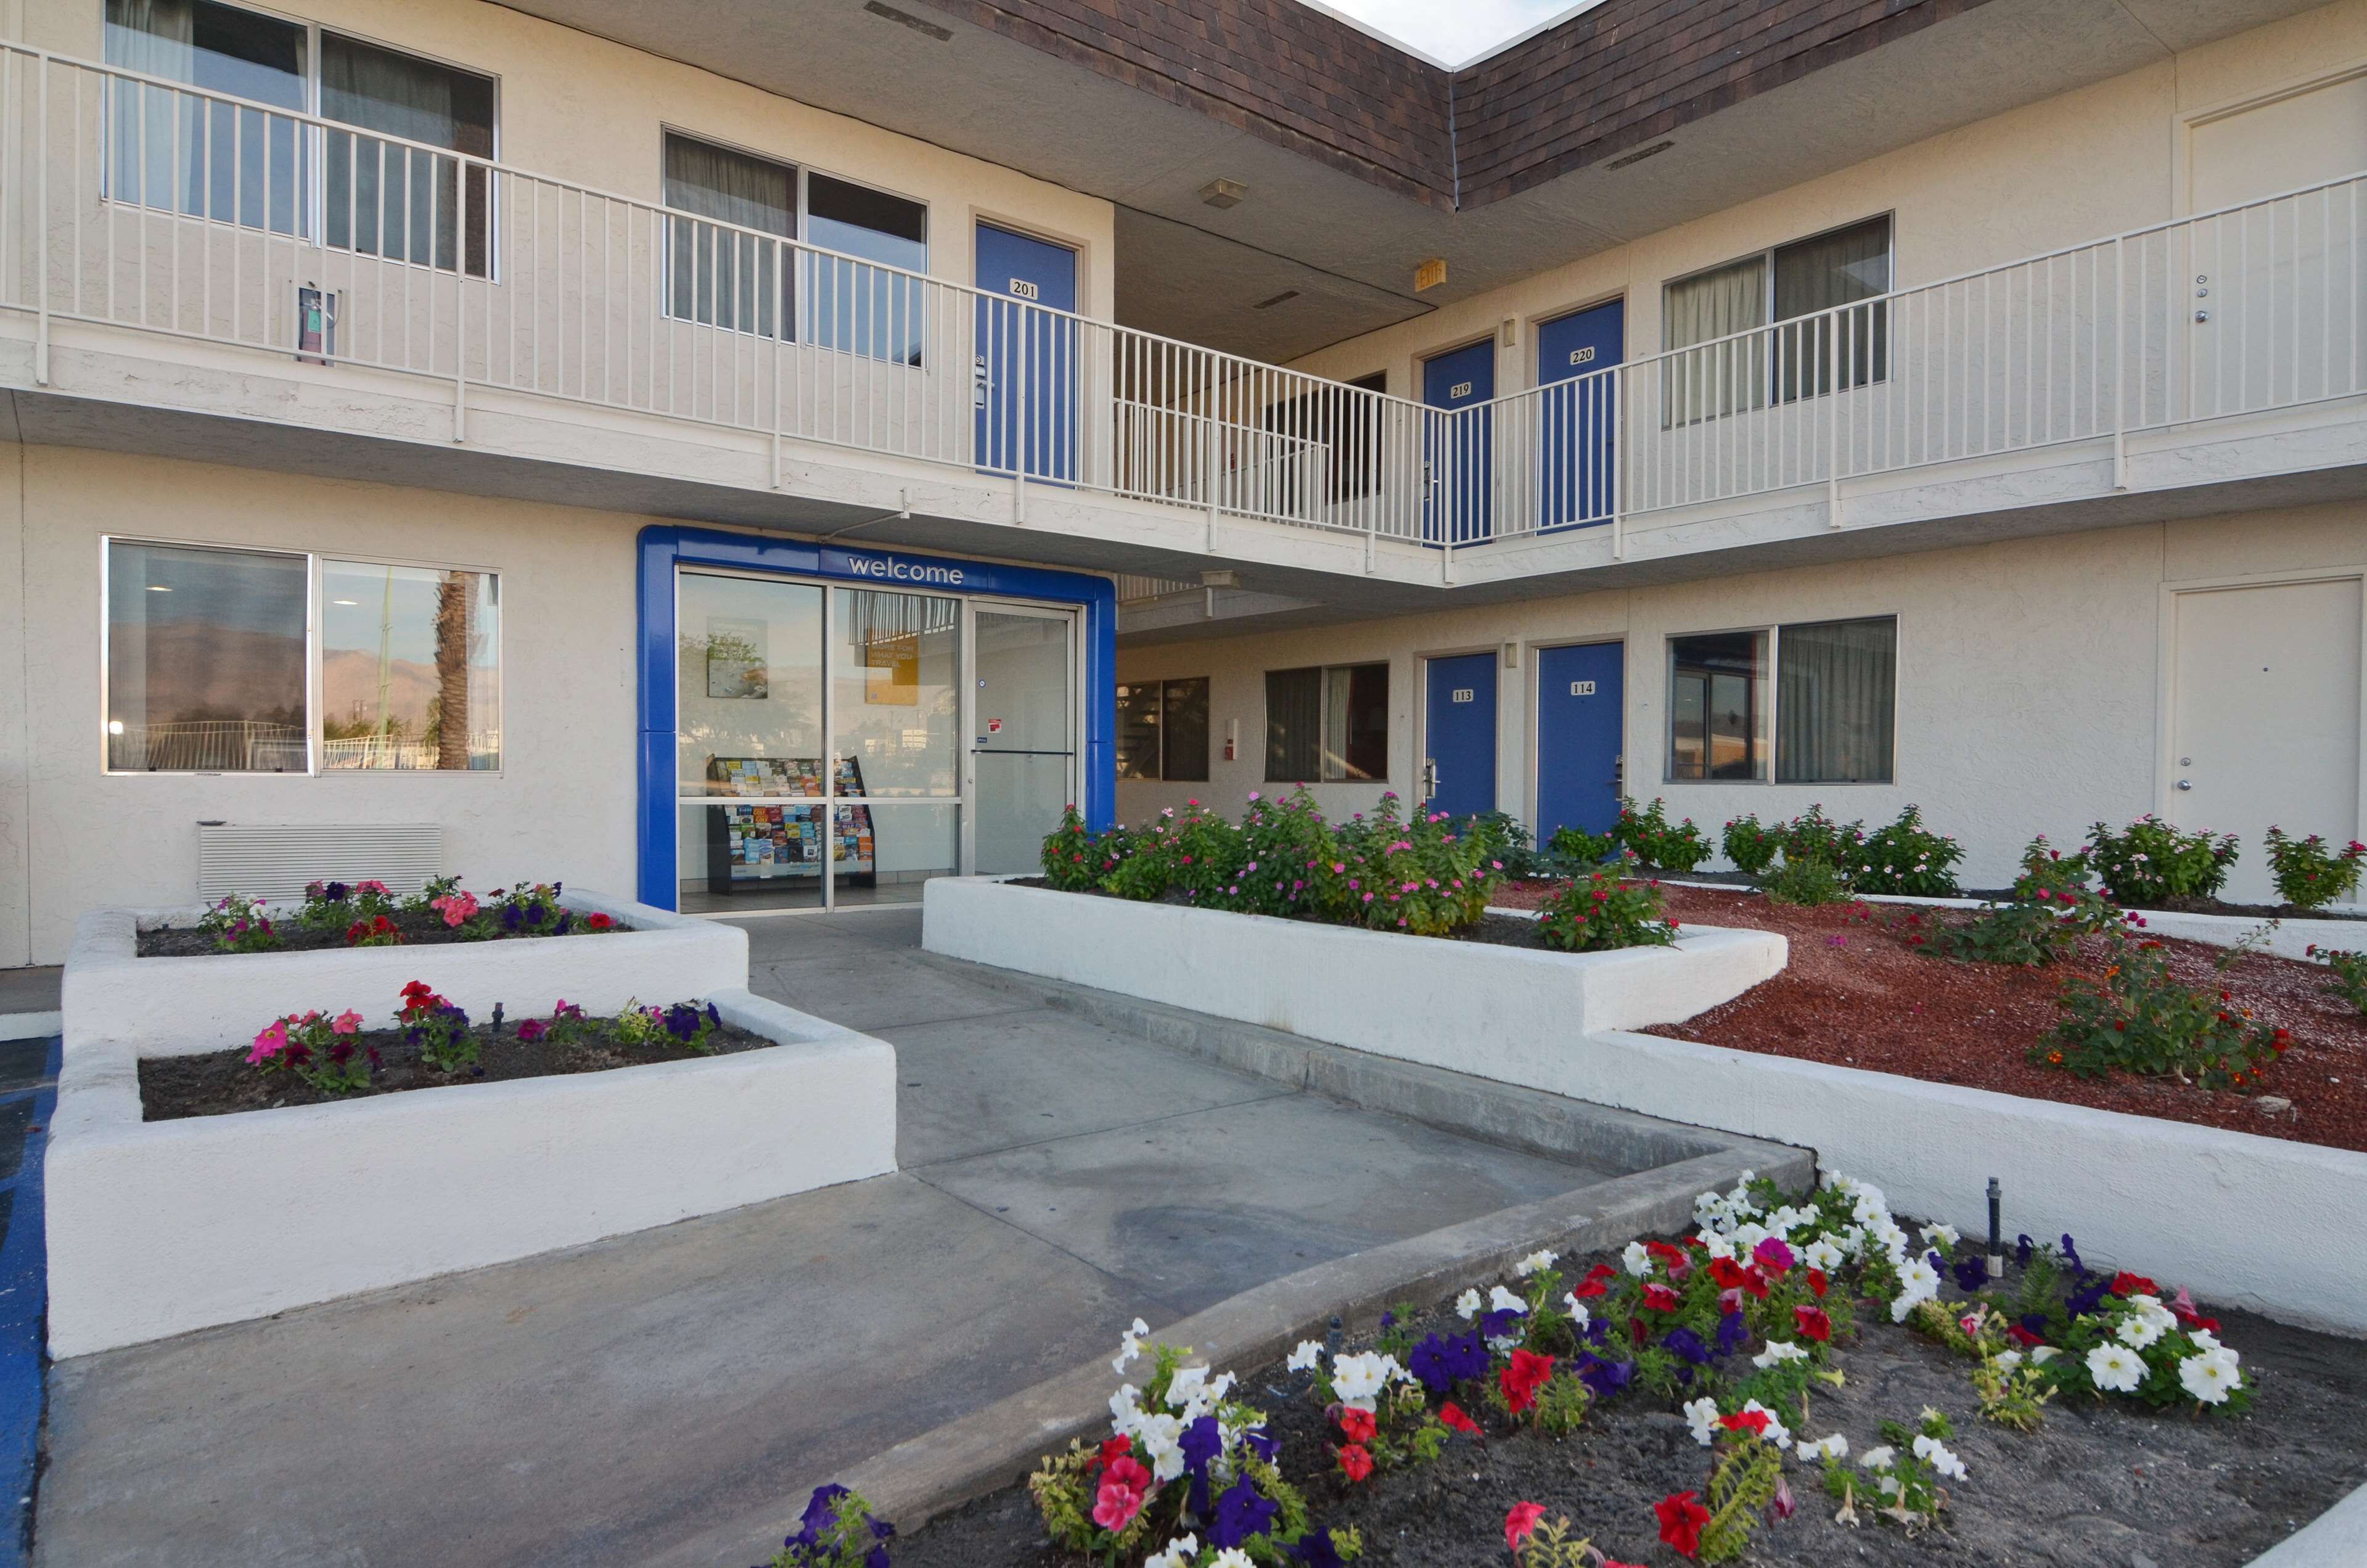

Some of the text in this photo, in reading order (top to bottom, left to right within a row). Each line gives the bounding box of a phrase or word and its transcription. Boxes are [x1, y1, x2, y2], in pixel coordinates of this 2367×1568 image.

[1420, 263, 1438, 287] EXIT
[1014, 281, 1034, 297] 201
[1573, 349, 1592, 363] 220
[1453, 384, 1469, 396] 219
[848, 556, 964, 585] welcome
[1575, 683, 1592, 693] 114
[1456, 691, 1471, 700] 113
